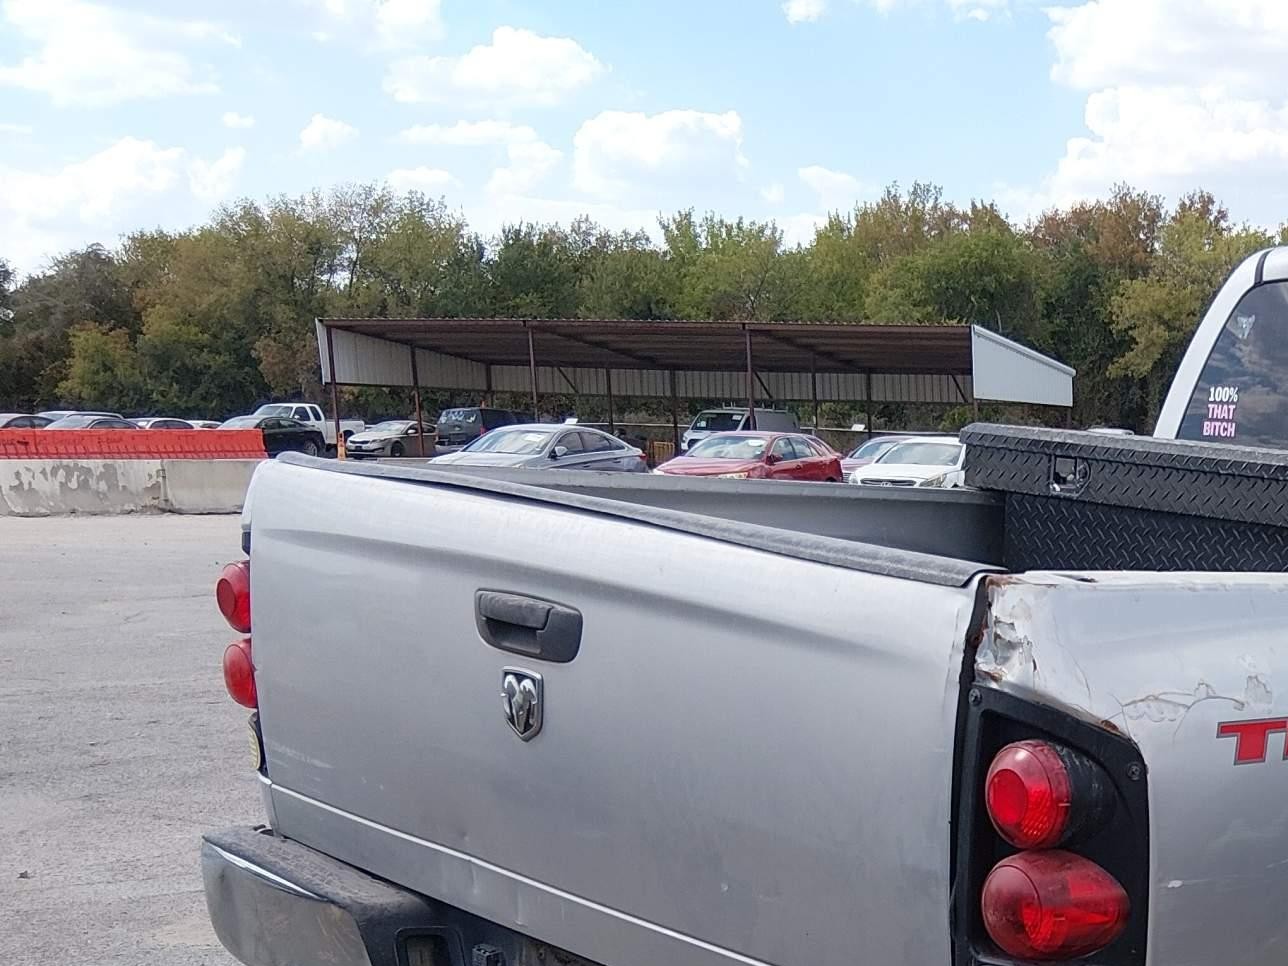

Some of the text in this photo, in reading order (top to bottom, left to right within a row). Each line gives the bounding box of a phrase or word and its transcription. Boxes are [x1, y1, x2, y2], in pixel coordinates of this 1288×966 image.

[1208, 386, 1239, 402] 100%
[1207, 404, 1236, 420] THAT
[1203, 421, 1236, 437] BITCH
